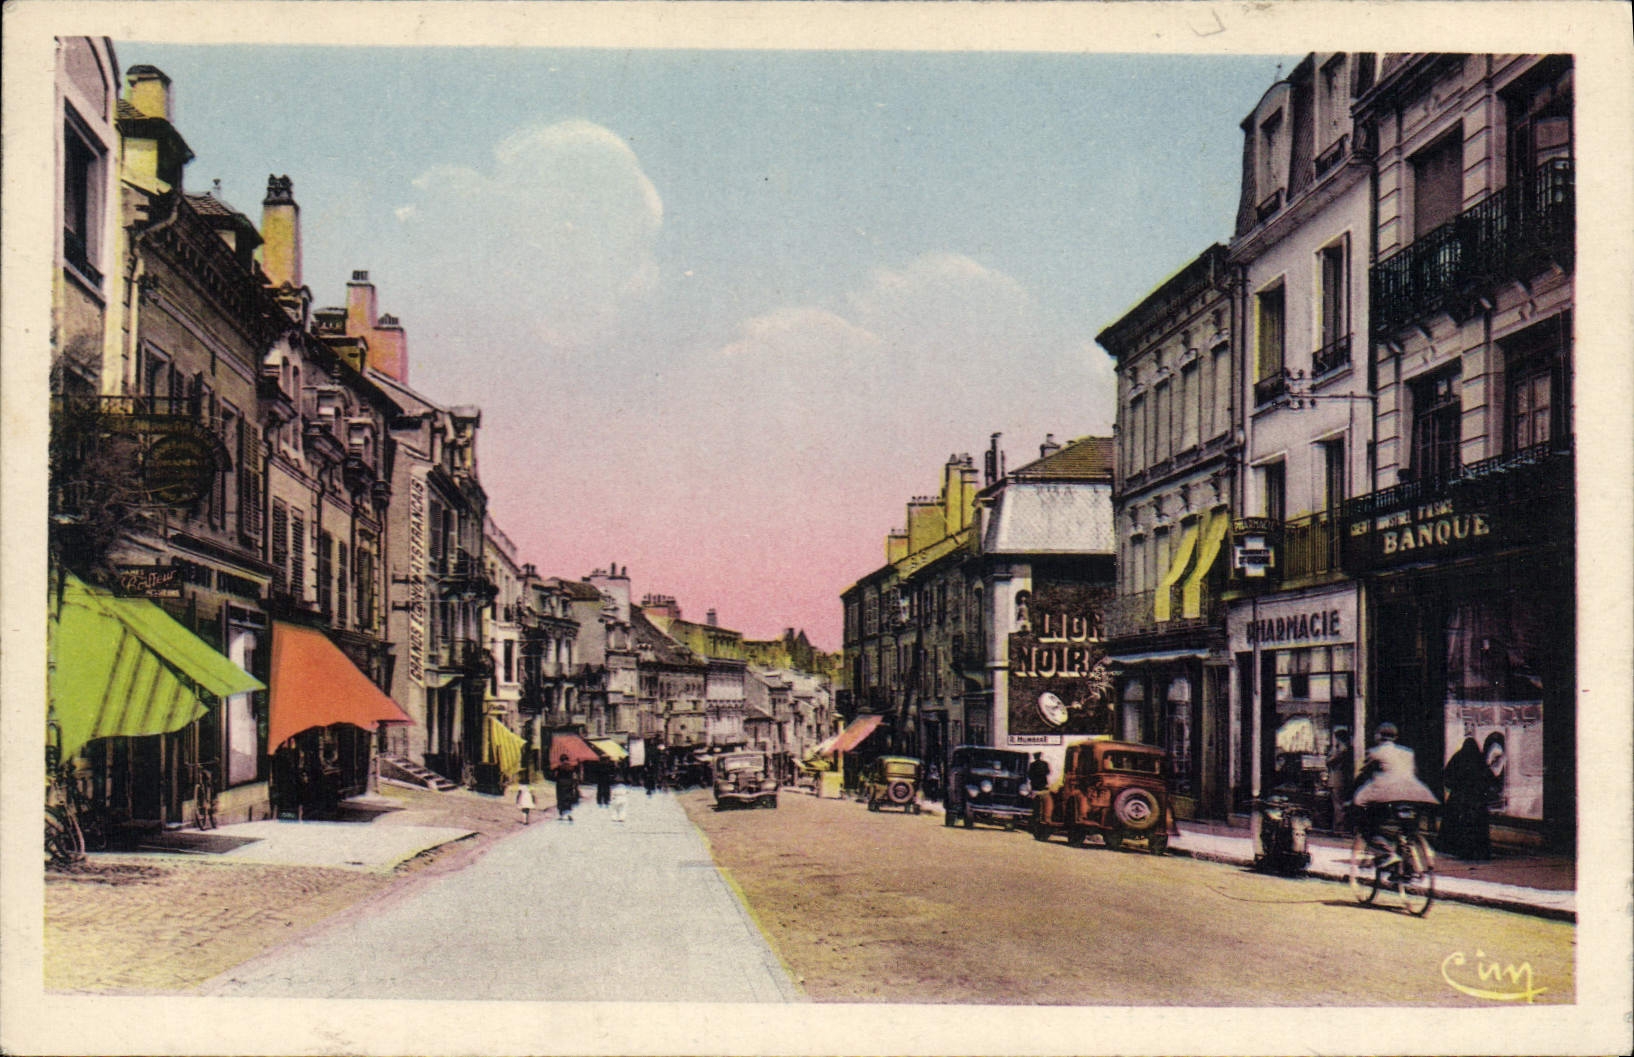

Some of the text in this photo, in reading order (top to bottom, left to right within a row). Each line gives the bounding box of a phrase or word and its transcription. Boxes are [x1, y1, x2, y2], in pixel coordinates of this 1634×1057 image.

[1382, 512, 1490, 555] BANQUE
[1246, 609, 1340, 644] PHARMACIE
[1013, 645, 1093, 678] NOIR
